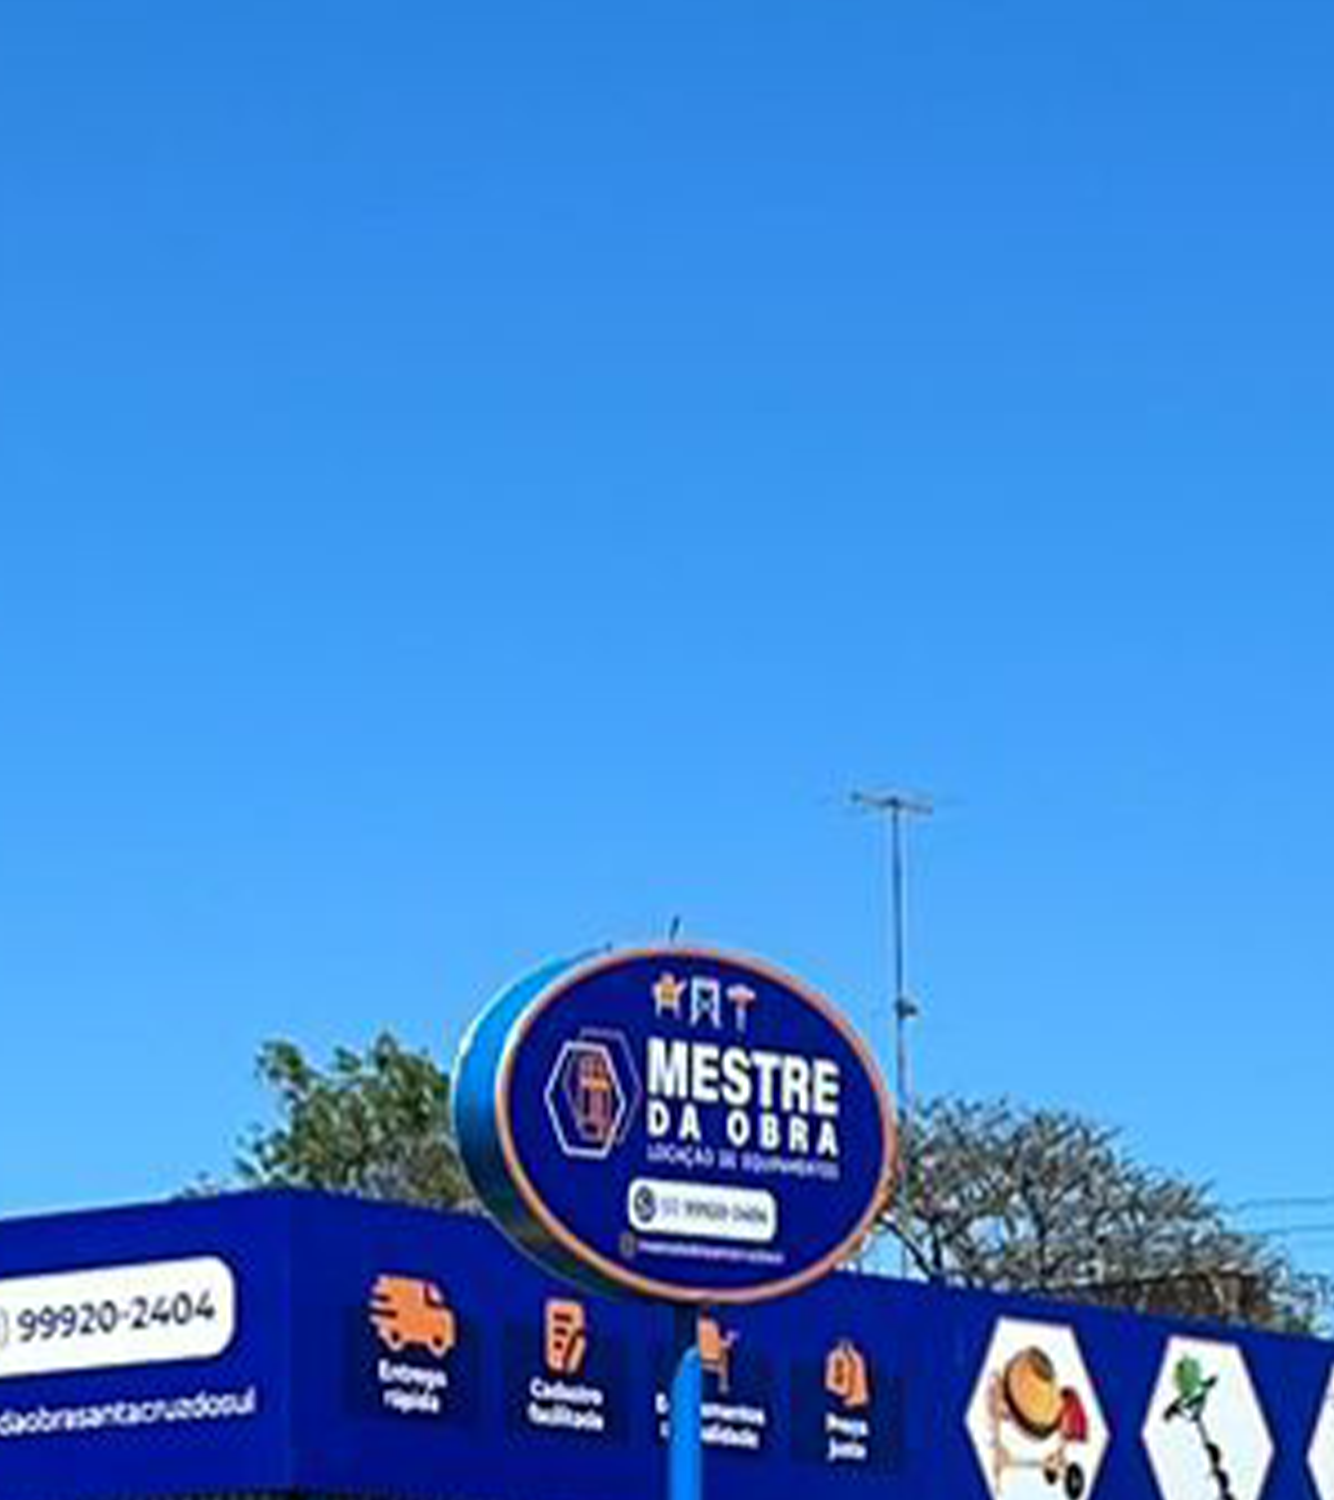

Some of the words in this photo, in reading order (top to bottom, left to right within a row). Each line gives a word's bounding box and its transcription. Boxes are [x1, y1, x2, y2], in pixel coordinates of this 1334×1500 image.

[646, 1037, 839, 1116] MESTRE
[648, 1101, 700, 1141] DA
[727, 1109, 839, 1156] OBRA
[647, 1143, 715, 1168] LOCAÇÃO
[17, 1290, 216, 1341] 99920-2404
